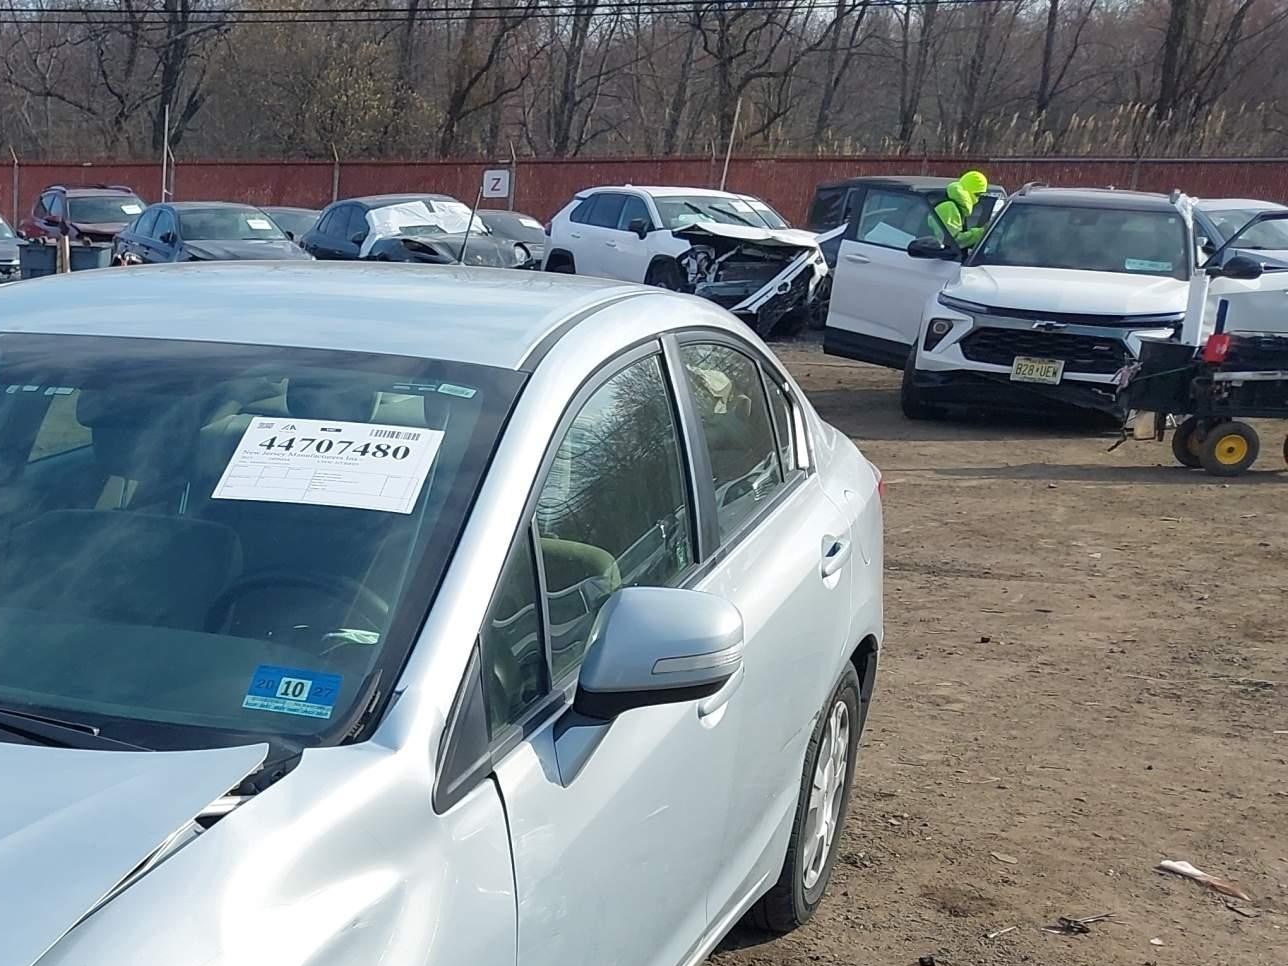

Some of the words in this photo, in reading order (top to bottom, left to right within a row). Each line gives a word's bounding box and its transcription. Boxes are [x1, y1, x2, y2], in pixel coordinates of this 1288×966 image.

[490, 177, 501, 191] Z
[258, 436, 410, 460] 44707480
[255, 679, 273, 689] 20
[280, 680, 305, 698] 10
